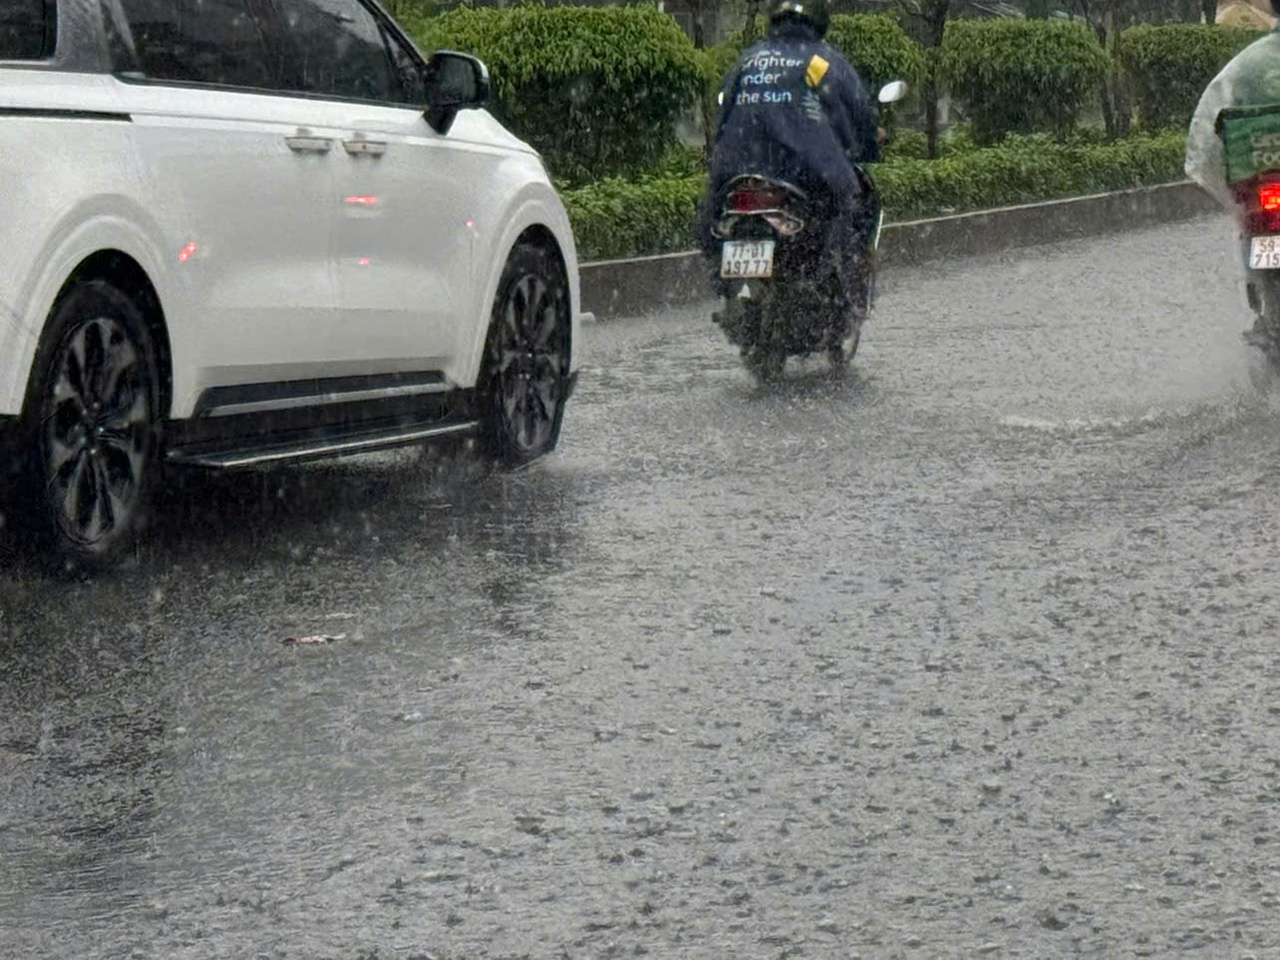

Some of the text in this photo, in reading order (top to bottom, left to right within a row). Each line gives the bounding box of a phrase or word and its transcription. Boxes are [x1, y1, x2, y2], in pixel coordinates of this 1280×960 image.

[742, 54, 804, 71] righter
[741, 71, 782, 85] nder
[736, 89, 792, 106] the sun
